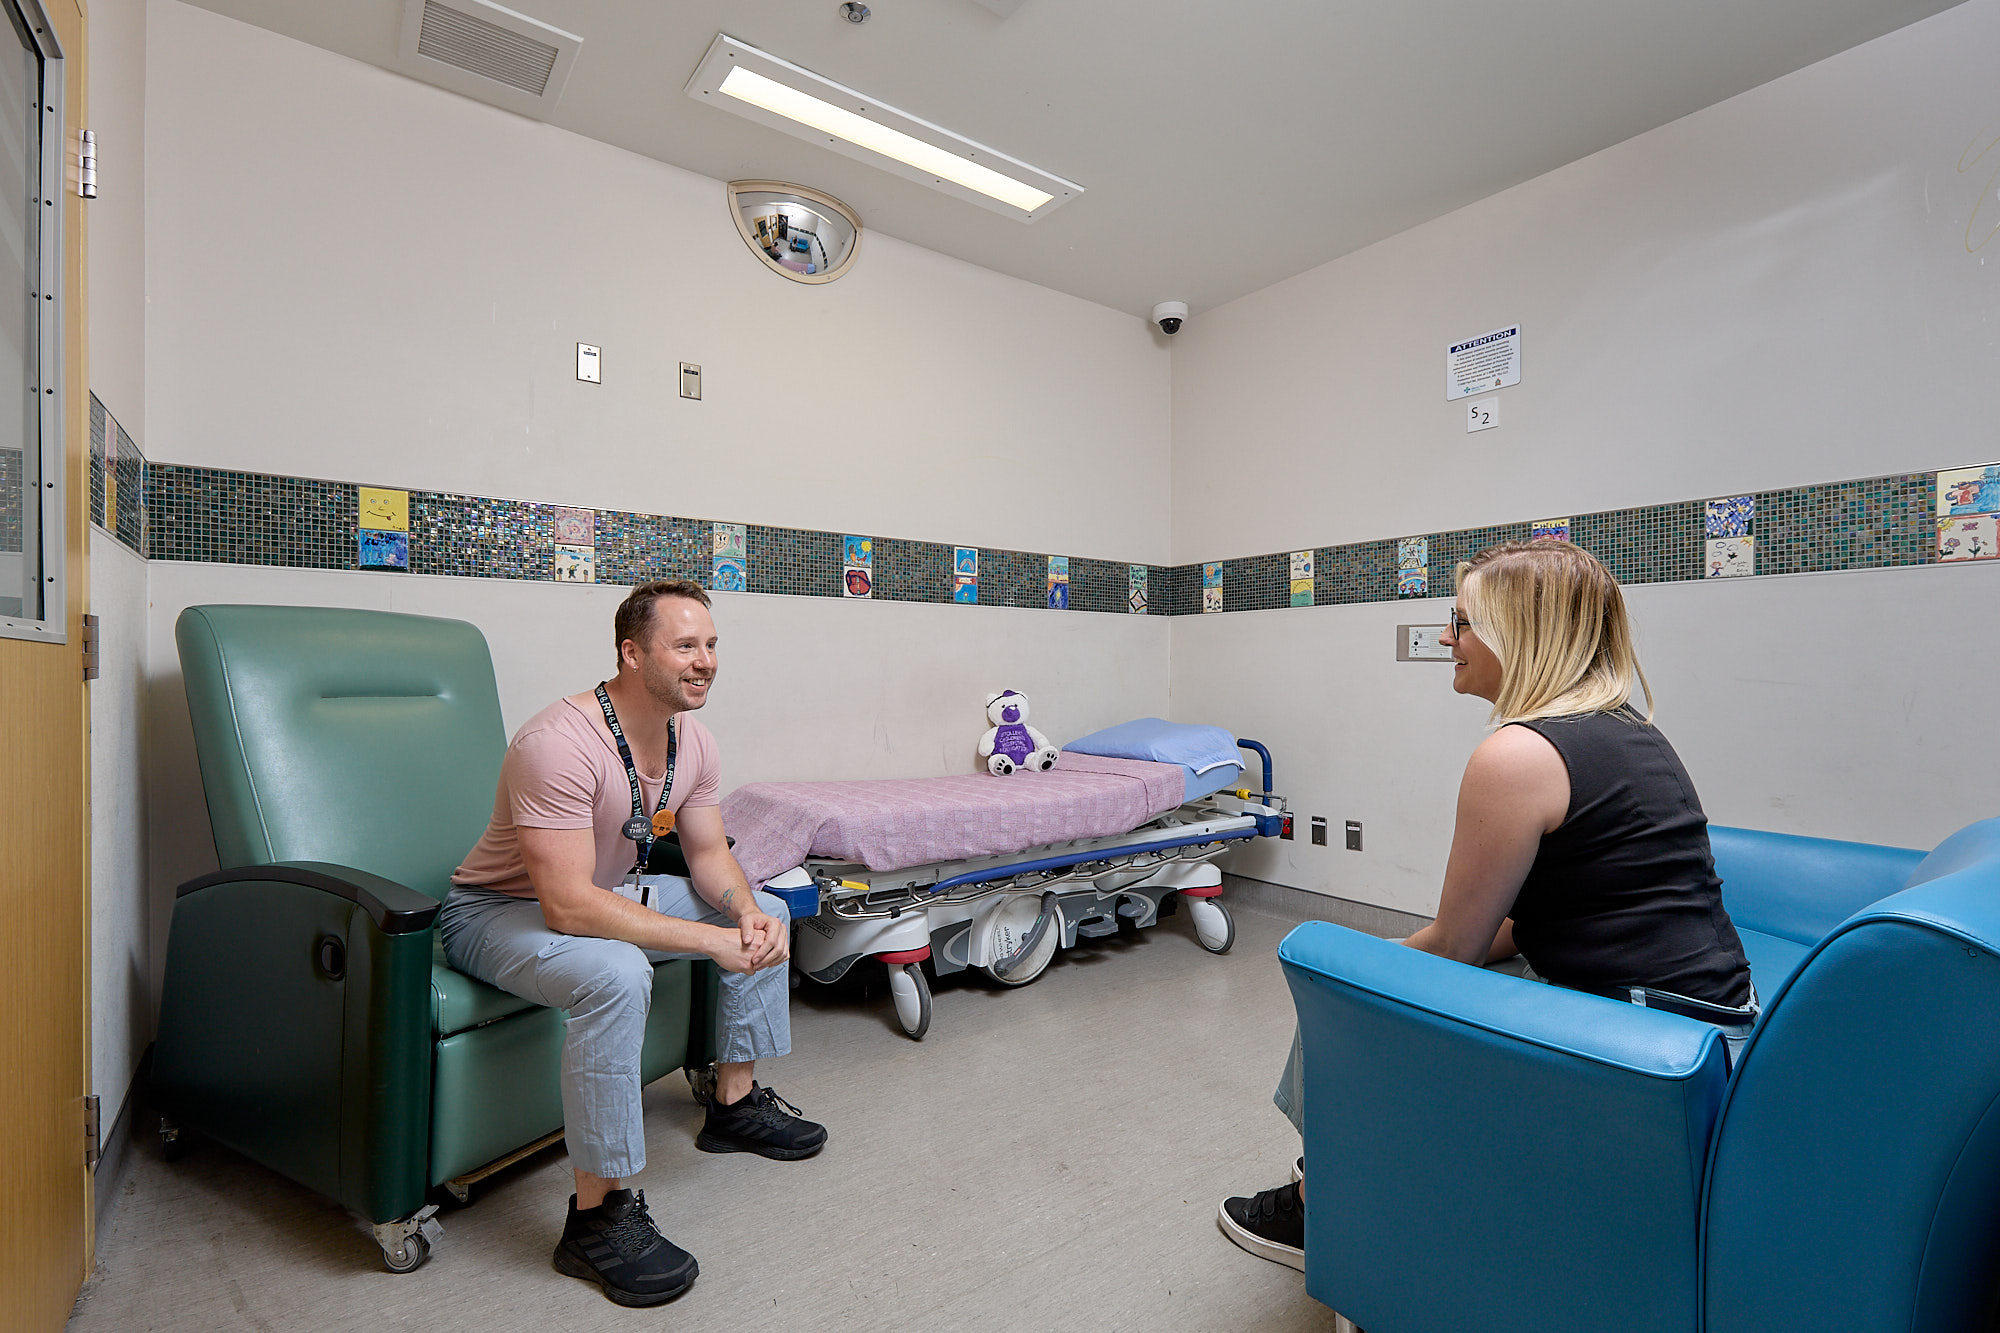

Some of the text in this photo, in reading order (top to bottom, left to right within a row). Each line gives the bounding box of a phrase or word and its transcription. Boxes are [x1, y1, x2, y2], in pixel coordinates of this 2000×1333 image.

[1455, 329, 1512, 352] ATTENTION
[1471, 406, 1490, 424] S 2
[602, 702, 614, 717] RN
[610, 723, 622, 737] RN
[628, 767, 637, 781] RN
[667, 770, 674, 783] RN
[632, 788, 640, 802] RN
[661, 790, 670, 804] RN
